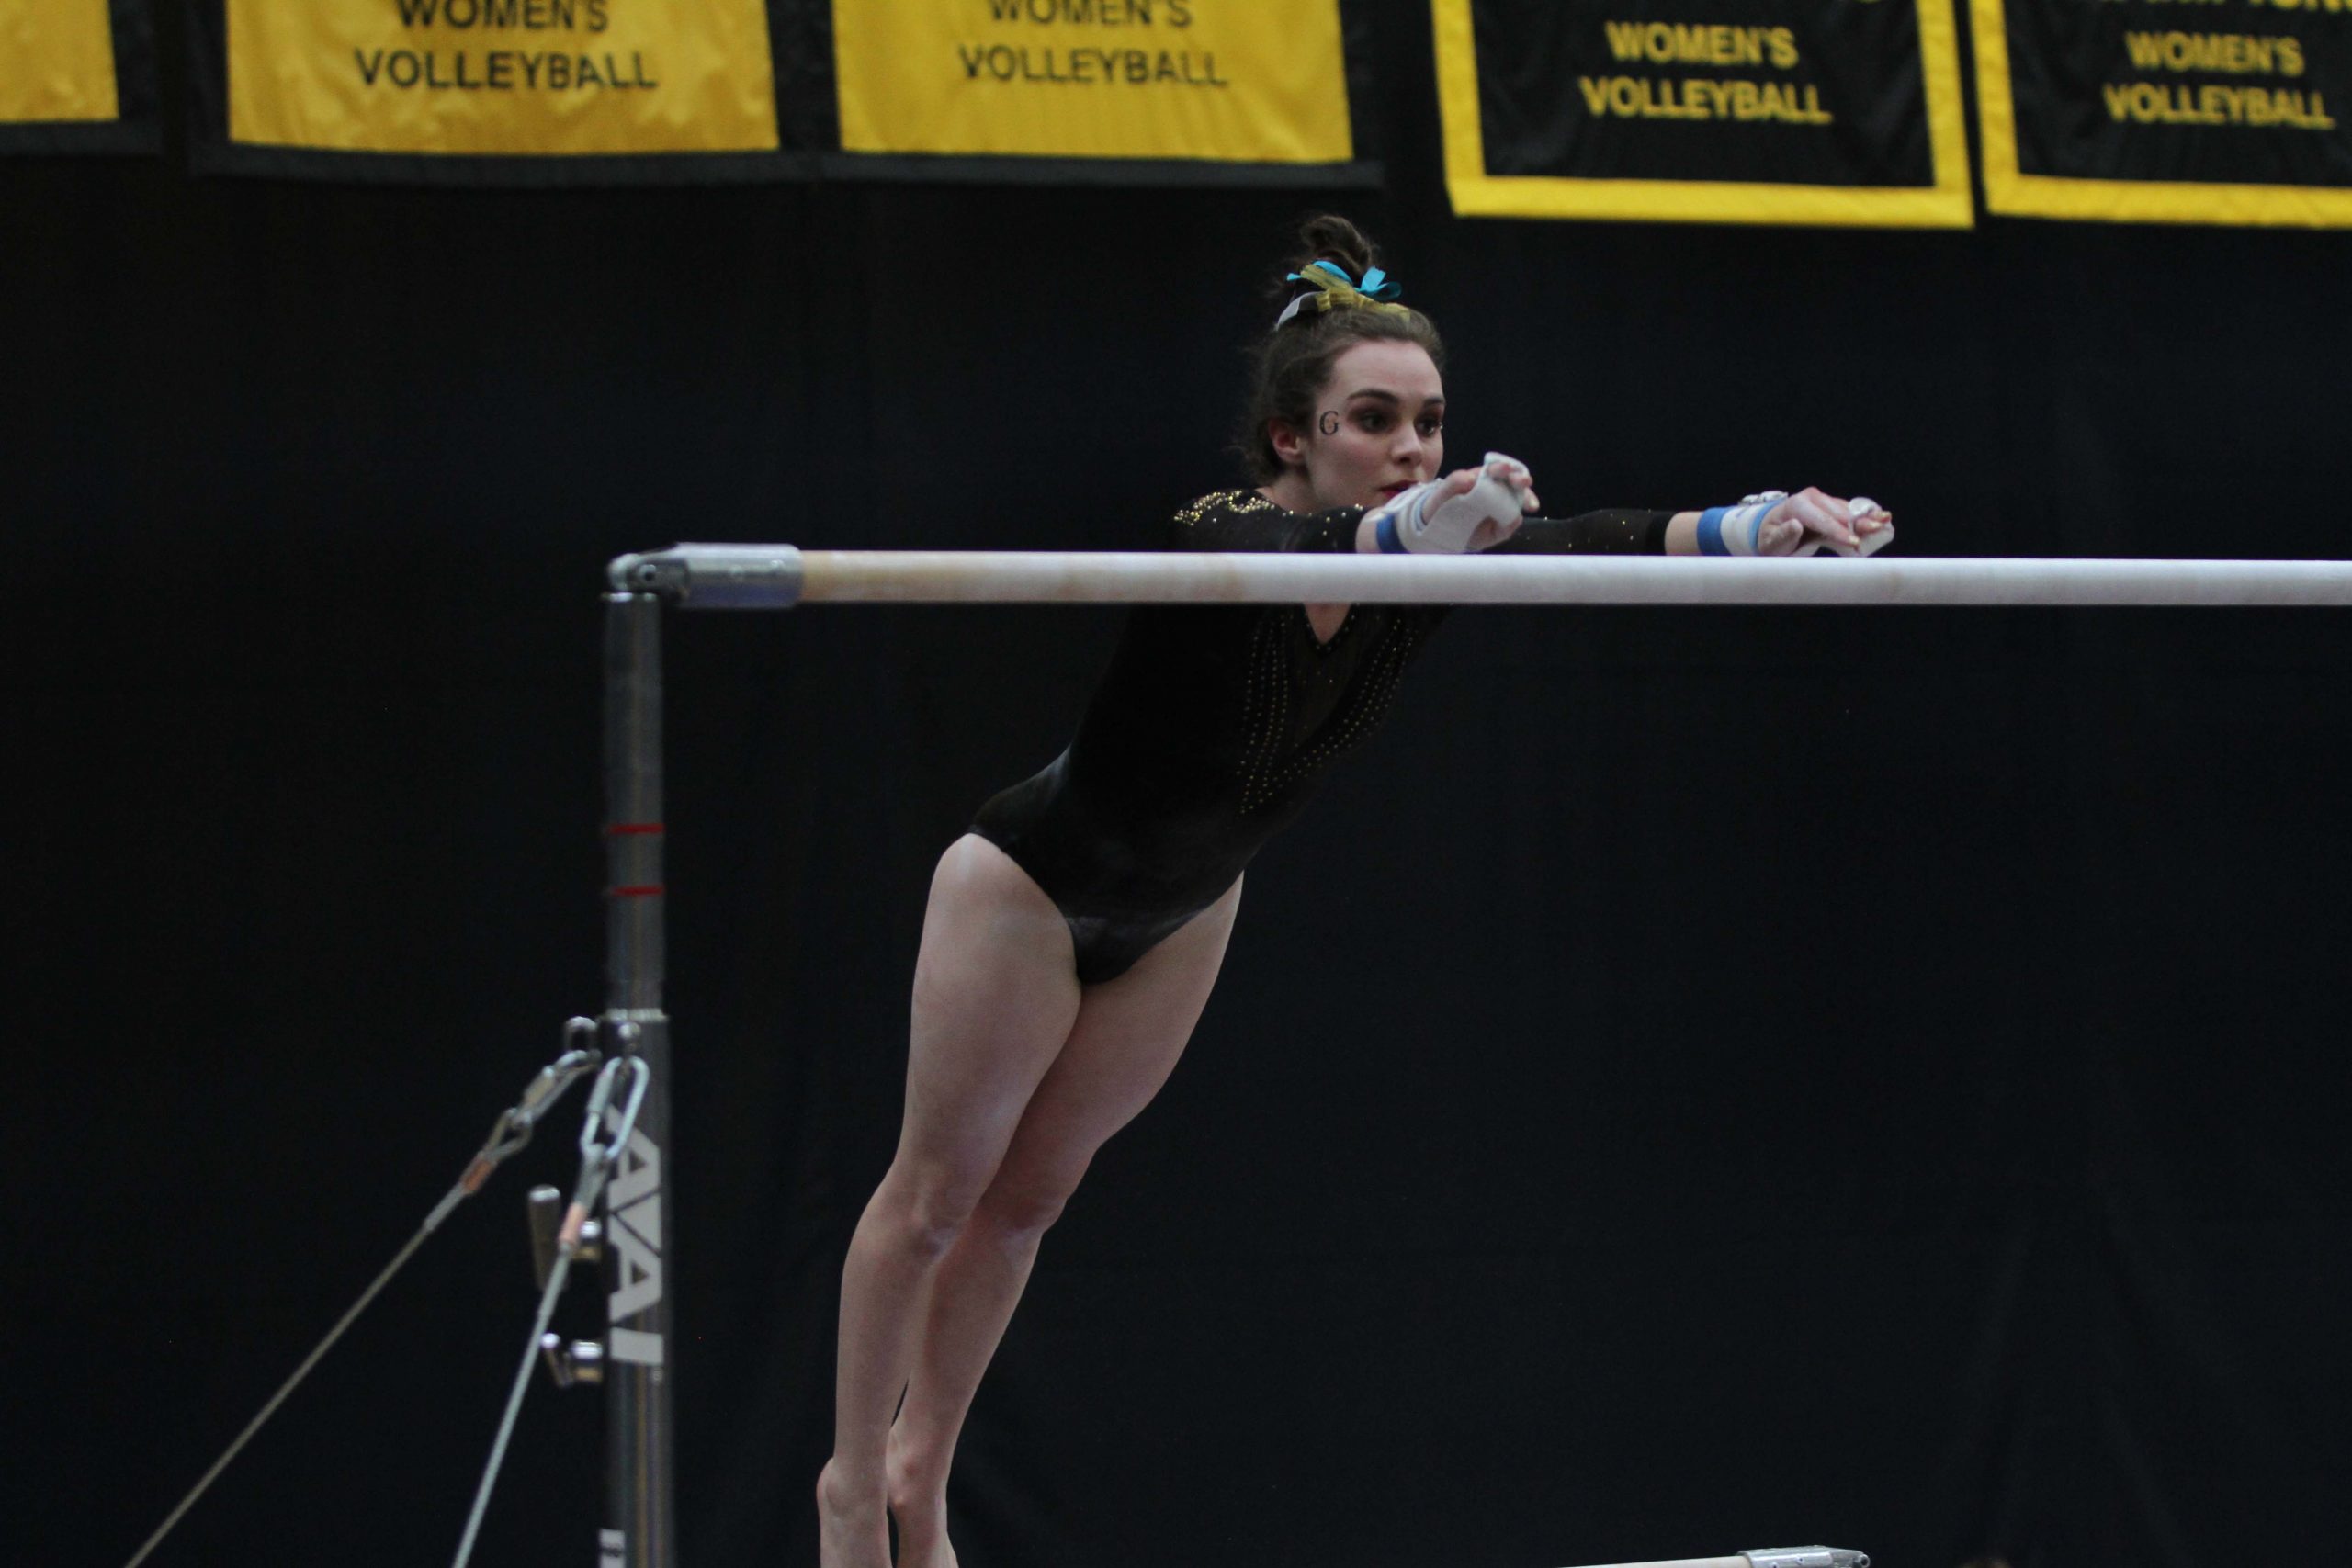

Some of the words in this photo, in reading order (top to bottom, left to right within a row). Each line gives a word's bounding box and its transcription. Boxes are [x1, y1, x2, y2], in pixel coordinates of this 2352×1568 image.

[397, 0, 608, 32] WOMENS
[990, 0, 1193, 28] WOMENS
[958, 44, 1228, 87] VOLLEYBALL
[1605, 21, 1798, 69] WOMEN'S
[2124, 31, 2305, 76] WOMEN'S
[355, 49, 659, 89] VOLLEYBALL
[1578, 76, 1833, 124] VOLLEYBALL
[2103, 83, 2335, 130] VOLLEYBALL
[1319, 410, 1339, 435] G
